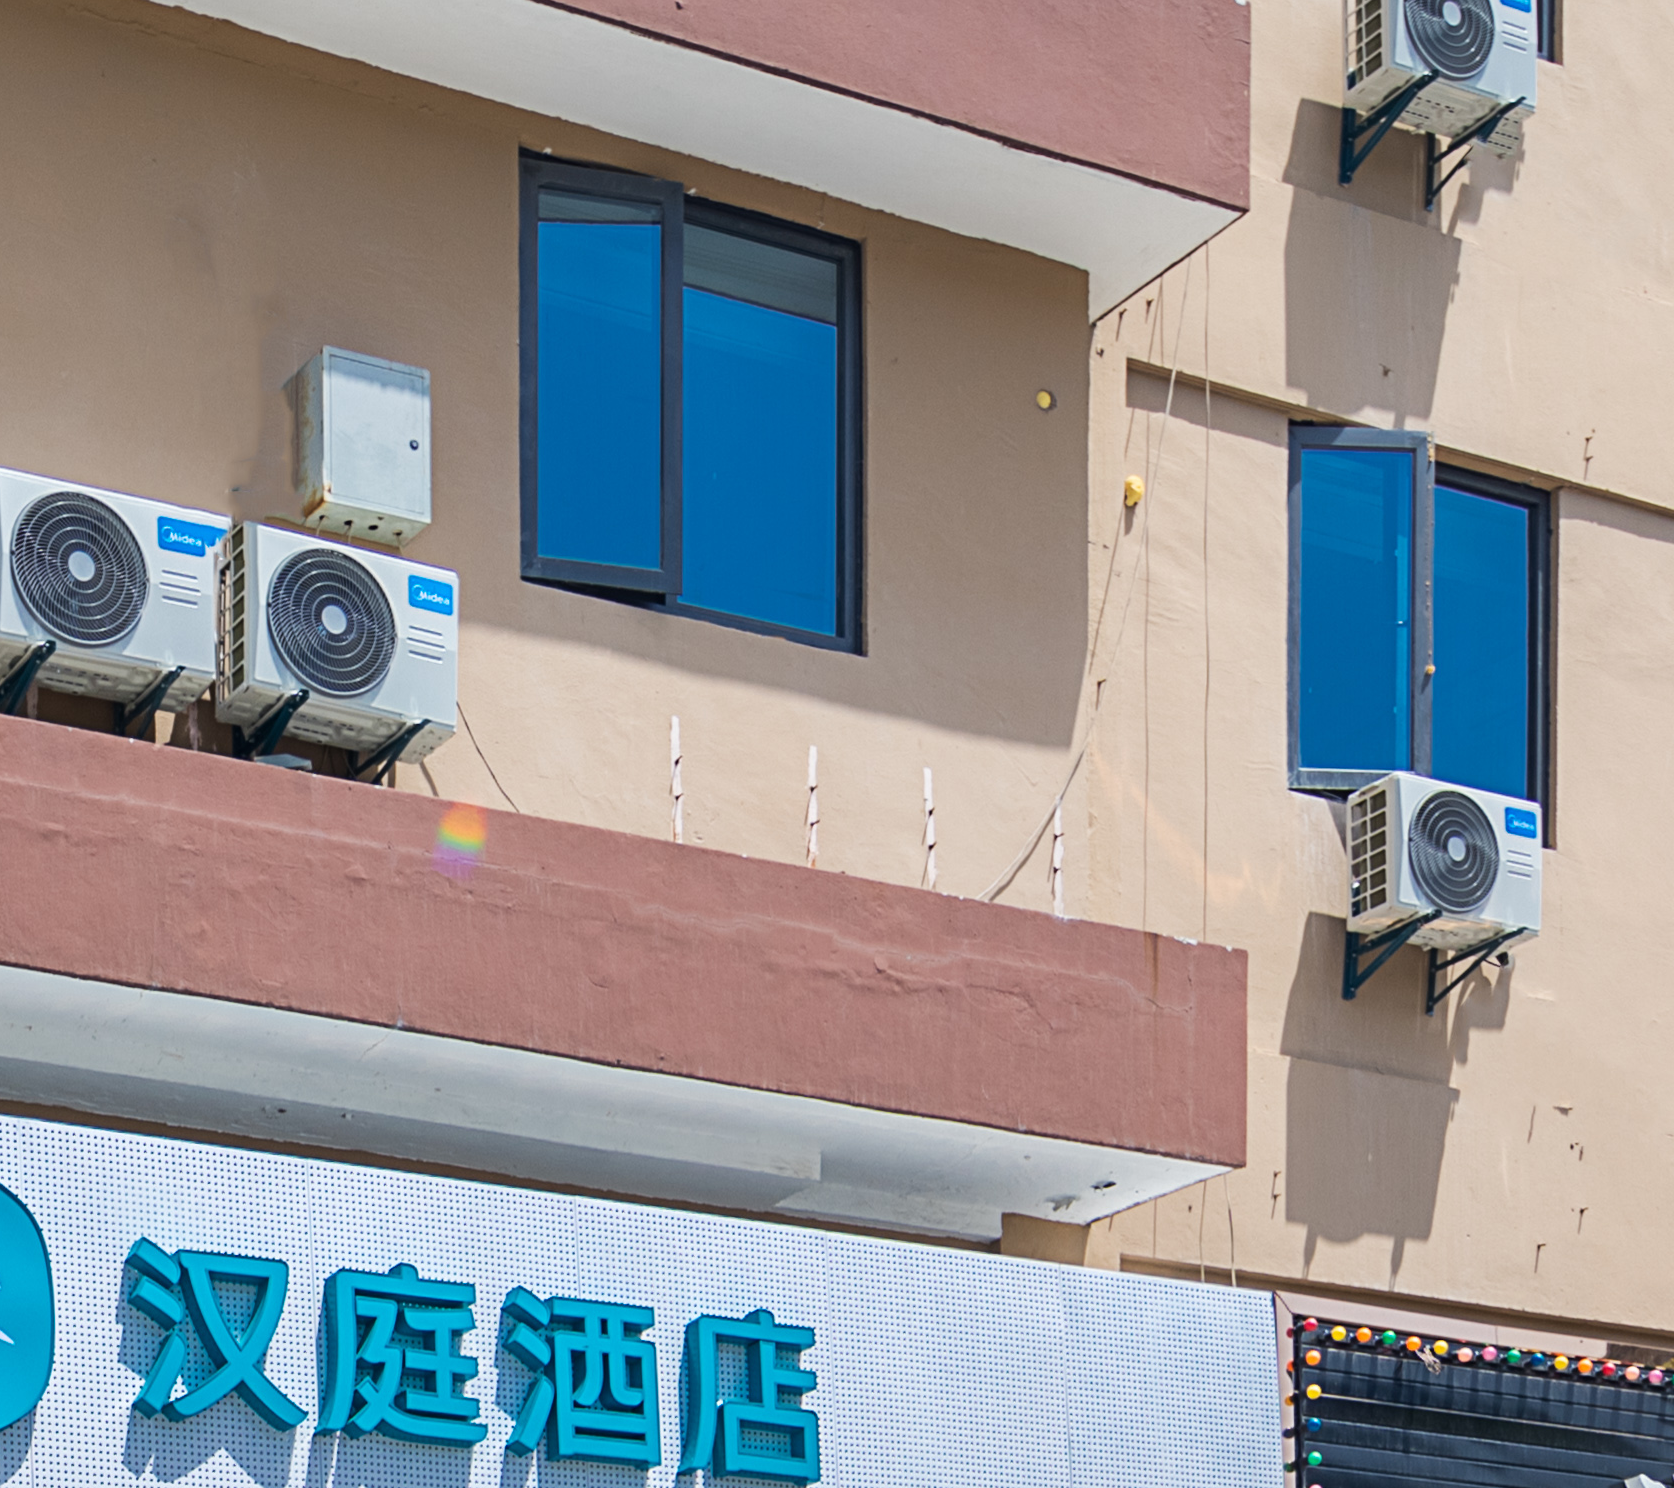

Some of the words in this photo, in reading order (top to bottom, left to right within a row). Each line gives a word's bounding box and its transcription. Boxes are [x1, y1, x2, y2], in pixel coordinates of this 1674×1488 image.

[161, 525, 203, 548] Midea
[411, 584, 450, 606] Midea
[124, 1236, 821, 1487] 汉庭酒店
